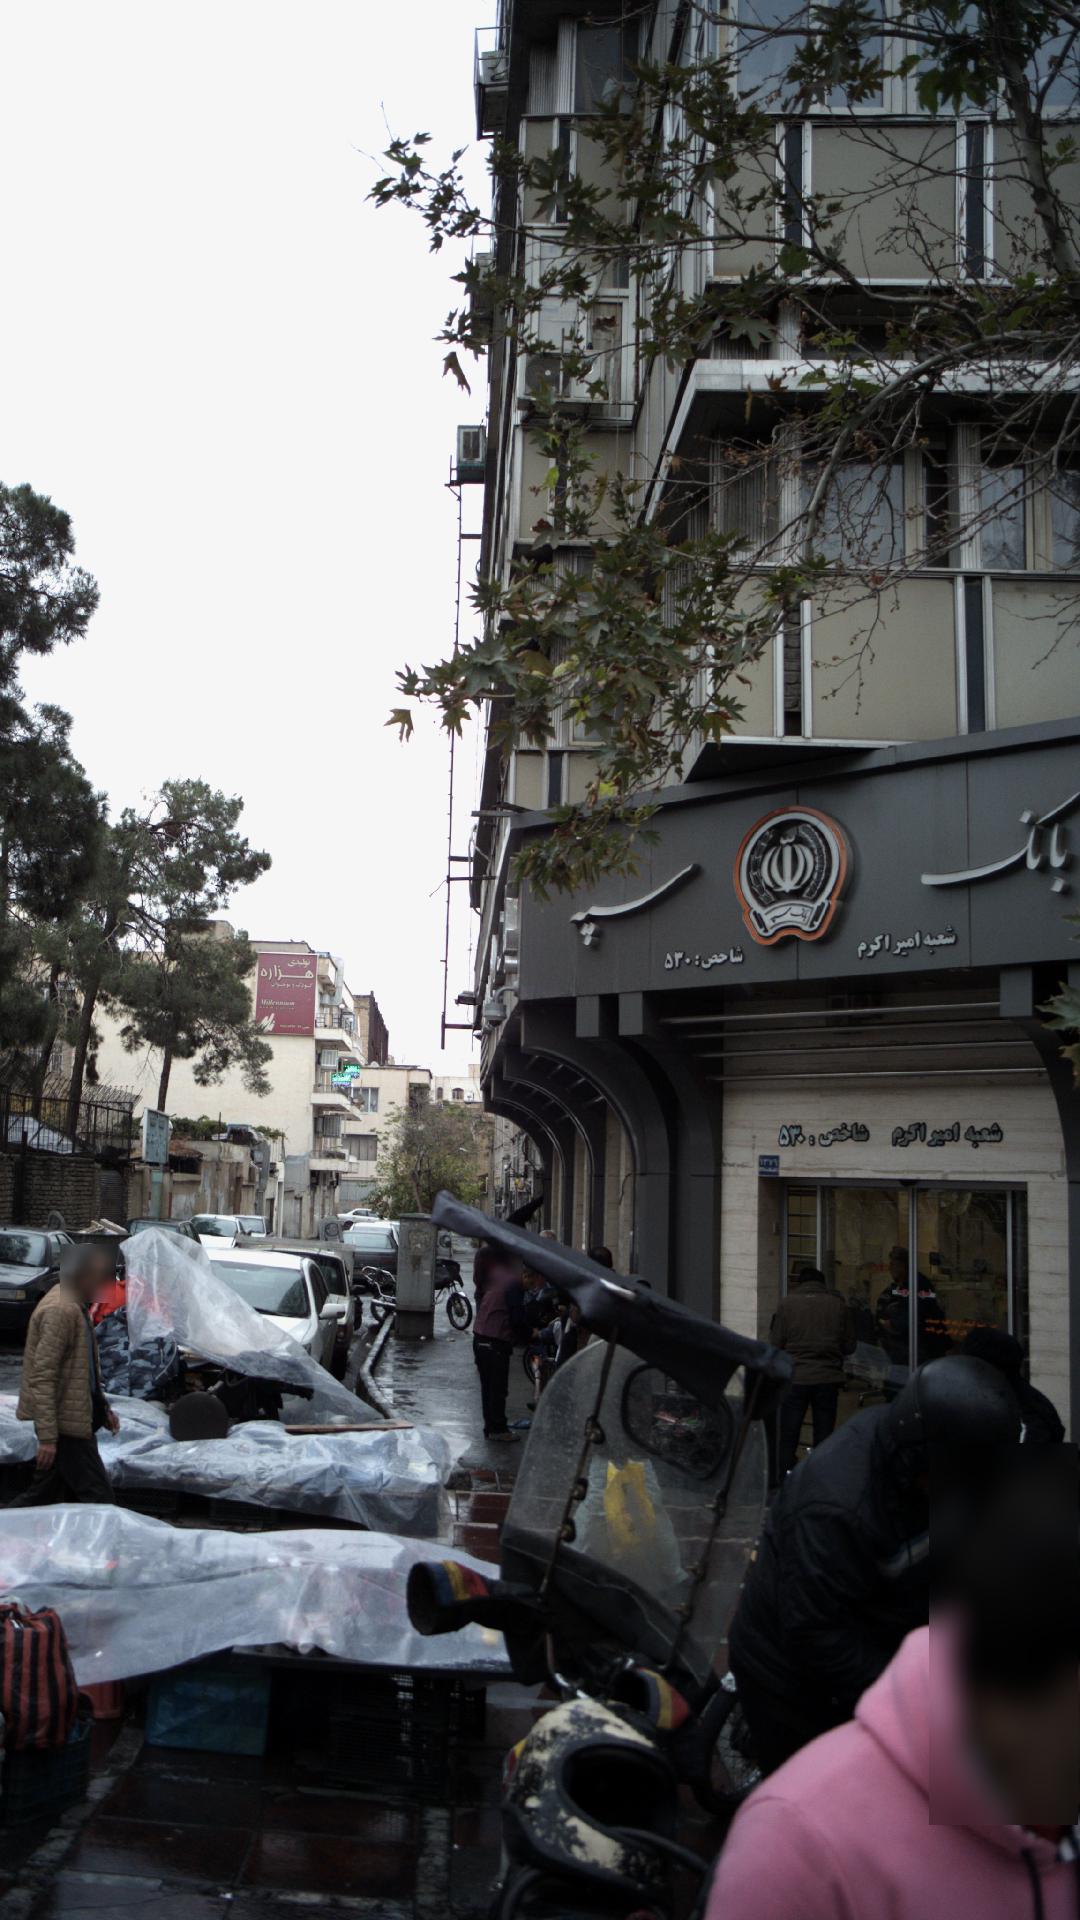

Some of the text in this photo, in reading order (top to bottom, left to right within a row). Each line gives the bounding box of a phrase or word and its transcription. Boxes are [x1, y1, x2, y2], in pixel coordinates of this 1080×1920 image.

[857, 925, 956, 959] شعبه امیر اکرم
[664, 951, 691, 969] ۵۳۰
[891, 1121, 927, 1147] اکرم
[926, 1121, 960, 1147] امیر
[964, 1122, 1004, 1149] شعبه
